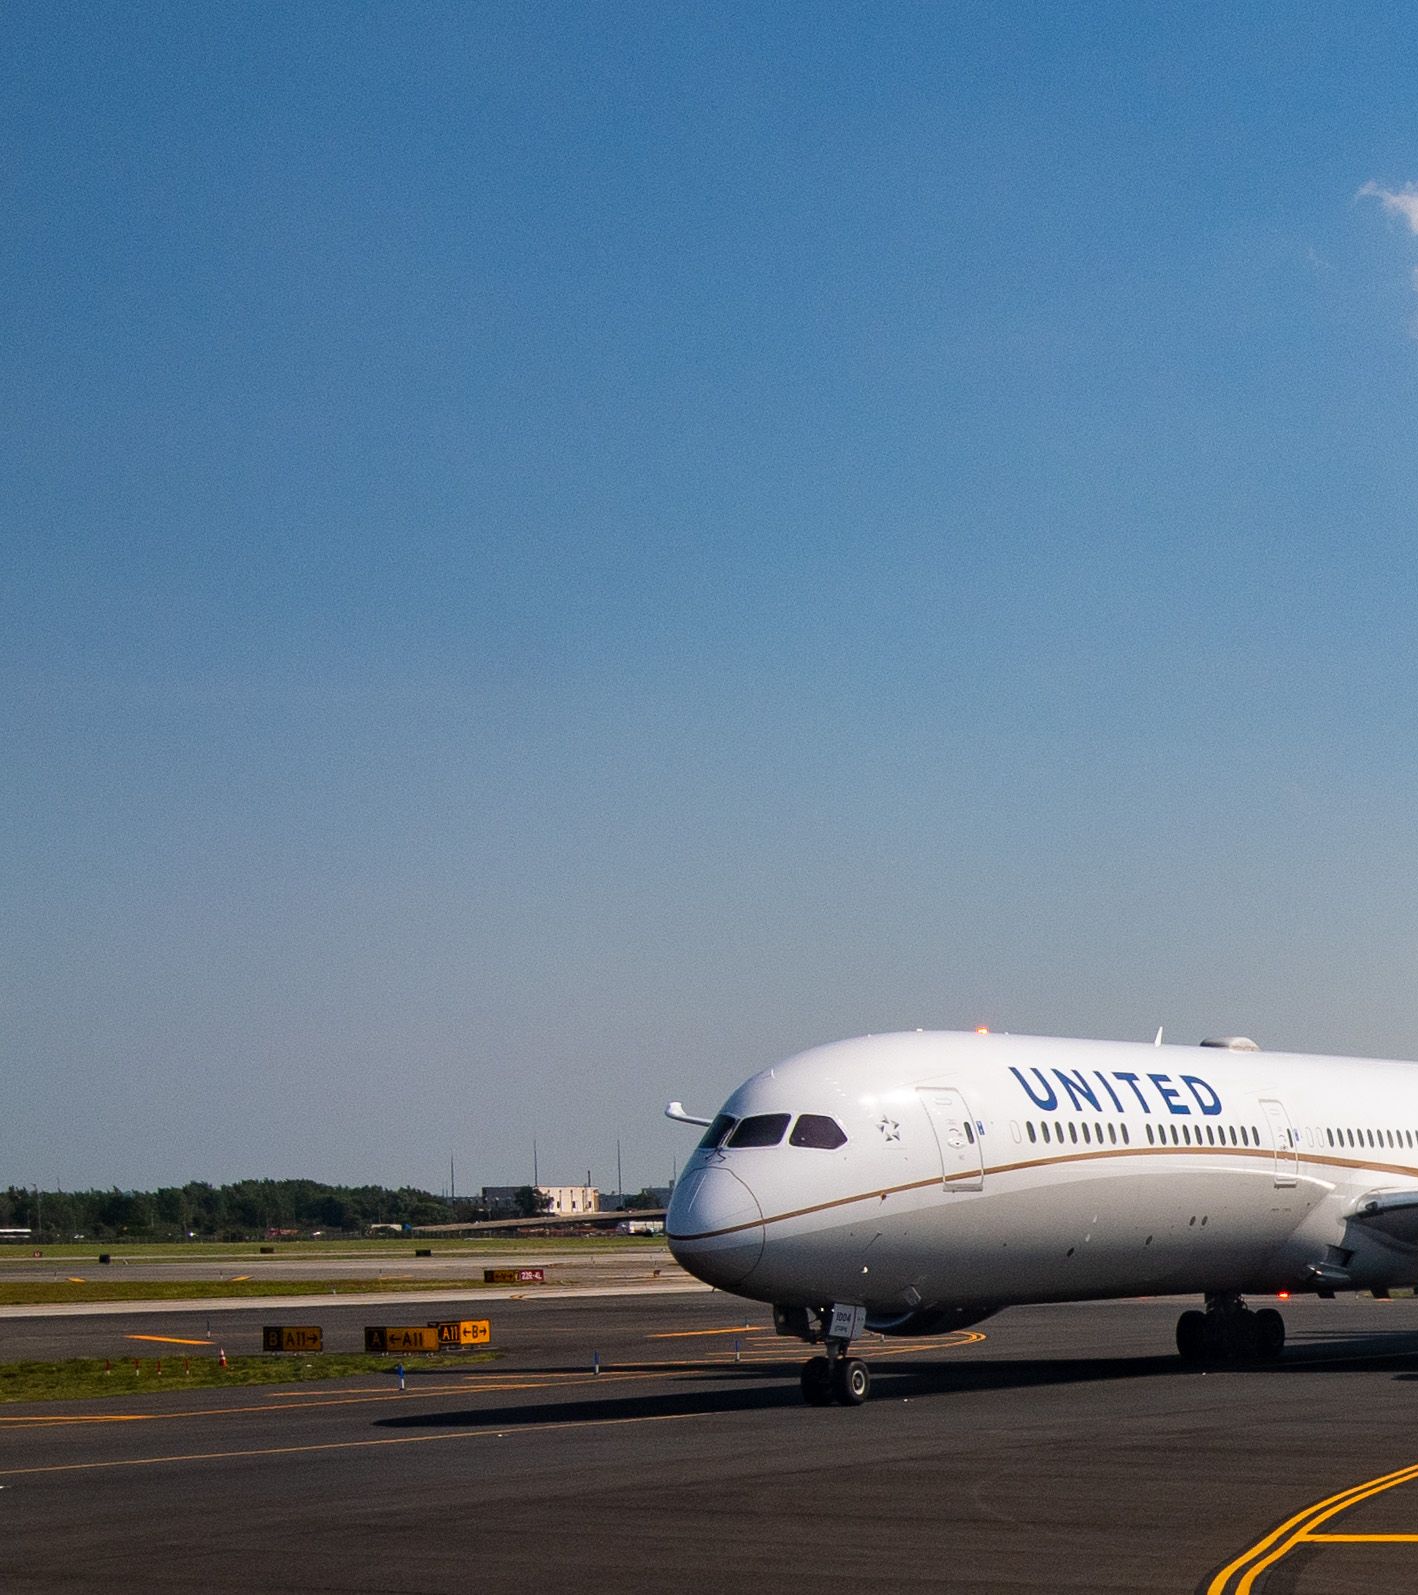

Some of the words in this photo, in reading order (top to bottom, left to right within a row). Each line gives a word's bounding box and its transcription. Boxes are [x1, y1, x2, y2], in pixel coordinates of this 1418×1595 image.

[1008, 1066, 1223, 1116] UNITED
[269, 1331, 278, 1346] B
[286, 1332, 306, 1346] A11
[371, 1331, 382, 1346] A
[402, 1331, 424, 1346] A11
[442, 1326, 458, 1340] A11
[471, 1325, 479, 1339] B
